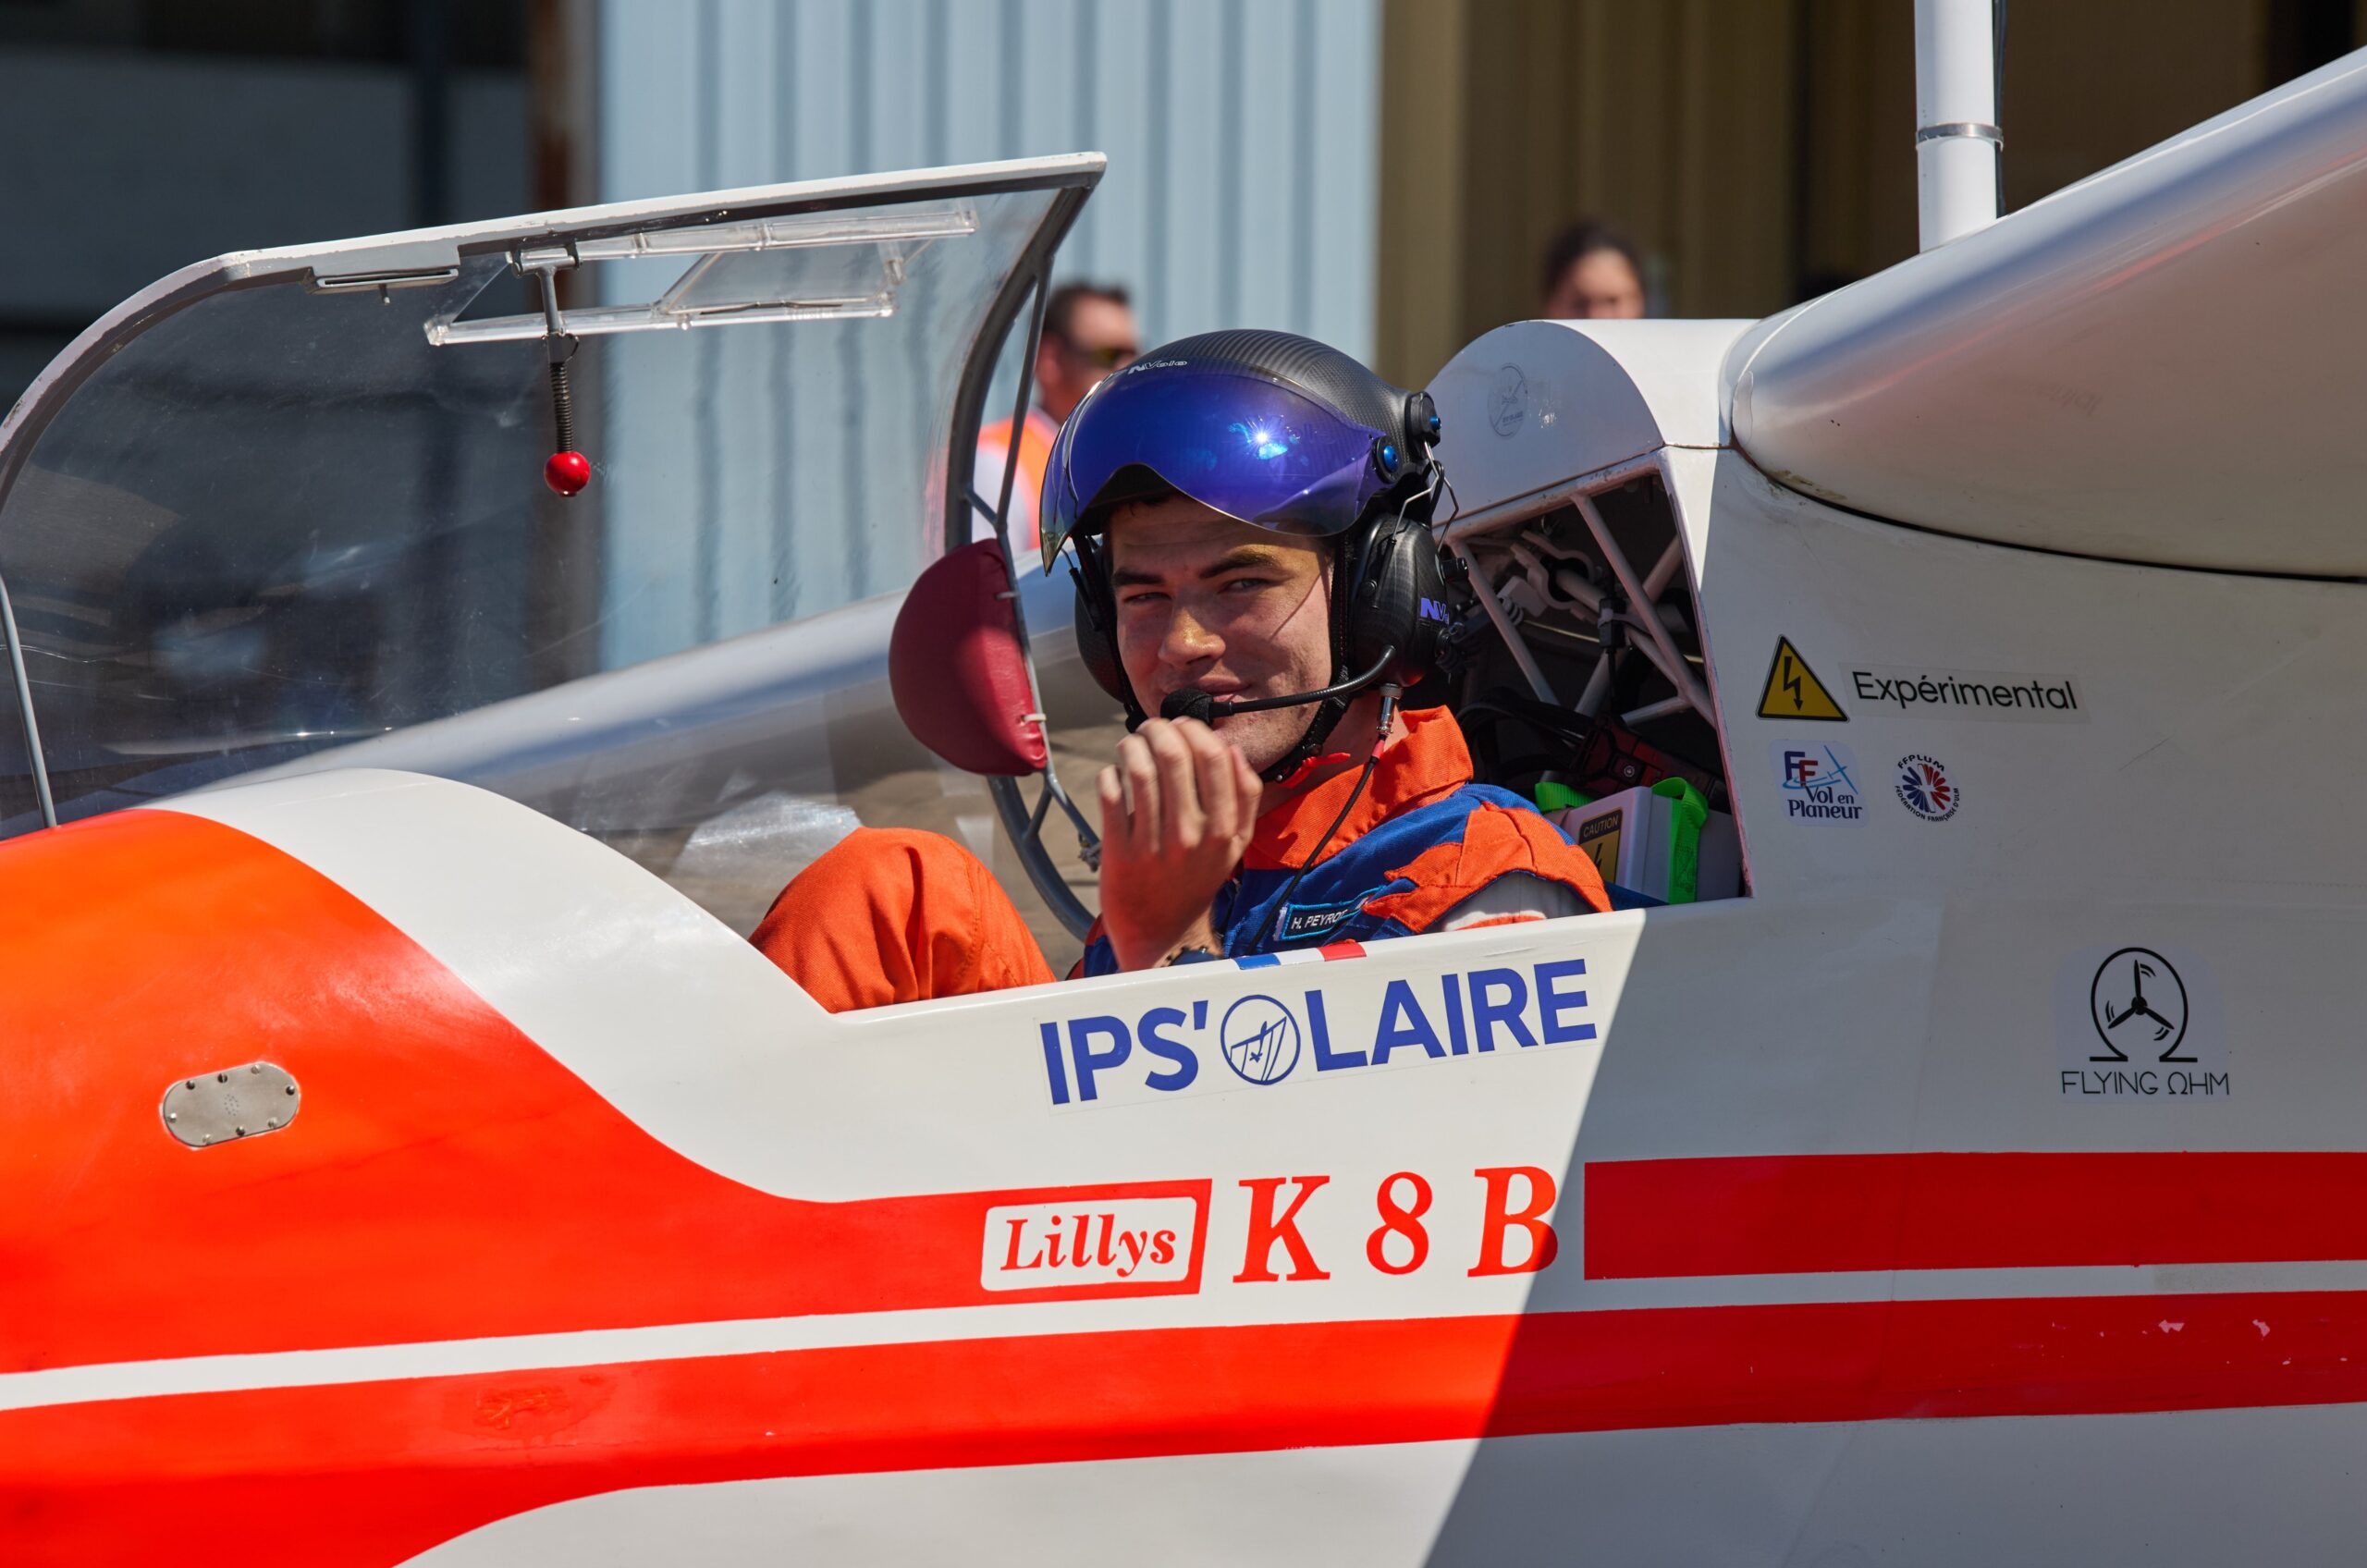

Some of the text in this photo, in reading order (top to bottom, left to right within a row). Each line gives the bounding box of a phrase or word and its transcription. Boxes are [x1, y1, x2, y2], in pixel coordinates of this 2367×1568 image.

[1852, 671, 2078, 709] Expérimental
[1897, 754, 1945, 772] FFPLUM
[1804, 785, 1855, 804] Vol en
[1787, 799, 1863, 819] Planeur
[1583, 815, 1619, 838] CAUTION
[1291, 916, 1302, 930] H.
[2061, 1071, 2159, 1095] FLYING
[1000, 1165, 1559, 1283] Lillys K 8 B
